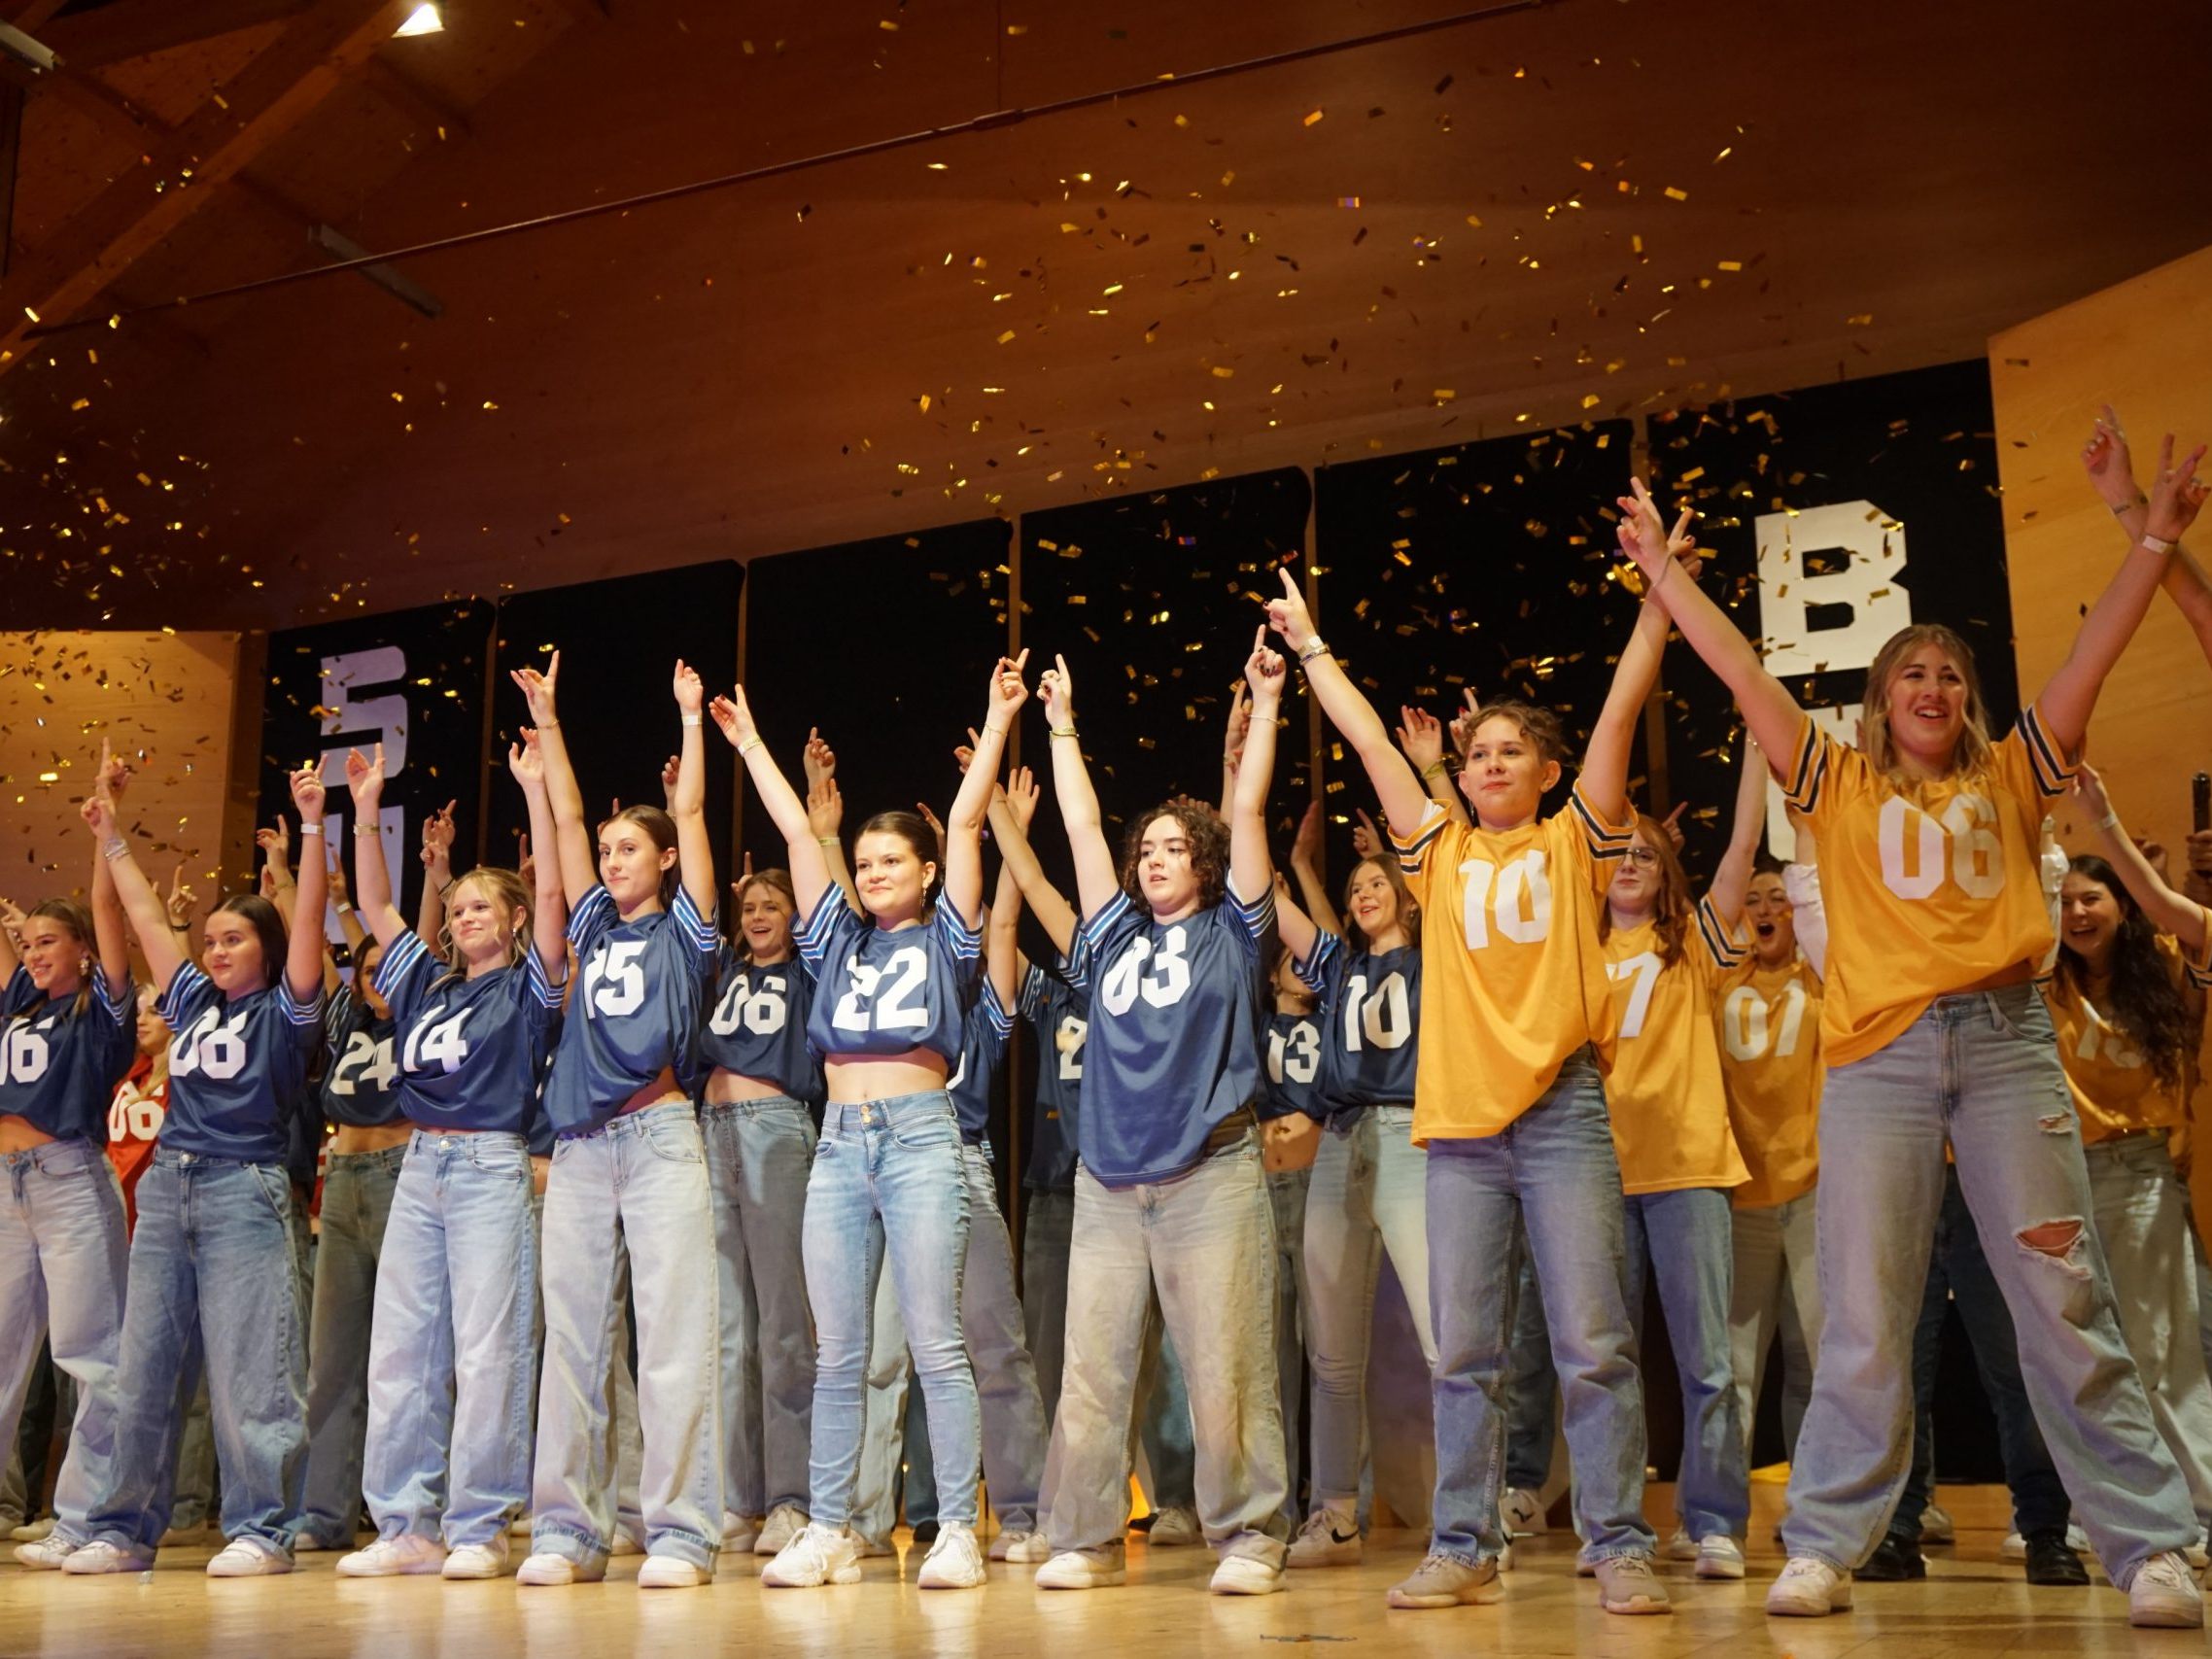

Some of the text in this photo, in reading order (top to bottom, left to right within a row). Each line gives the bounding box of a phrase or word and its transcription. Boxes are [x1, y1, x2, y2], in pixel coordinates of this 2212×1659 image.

[1879, 795, 2002, 900] 06
[1458, 849, 1552, 950] 10
[709, 976, 787, 1036] 06
[831, 946, 929, 1031] 22
[1102, 925, 1192, 1017] 03
[403, 1005, 472, 1074] 14
[1267, 1020, 1322, 1084] 13
[1344, 972, 1411, 1052] 10
[329, 1031, 398, 1095] 24
